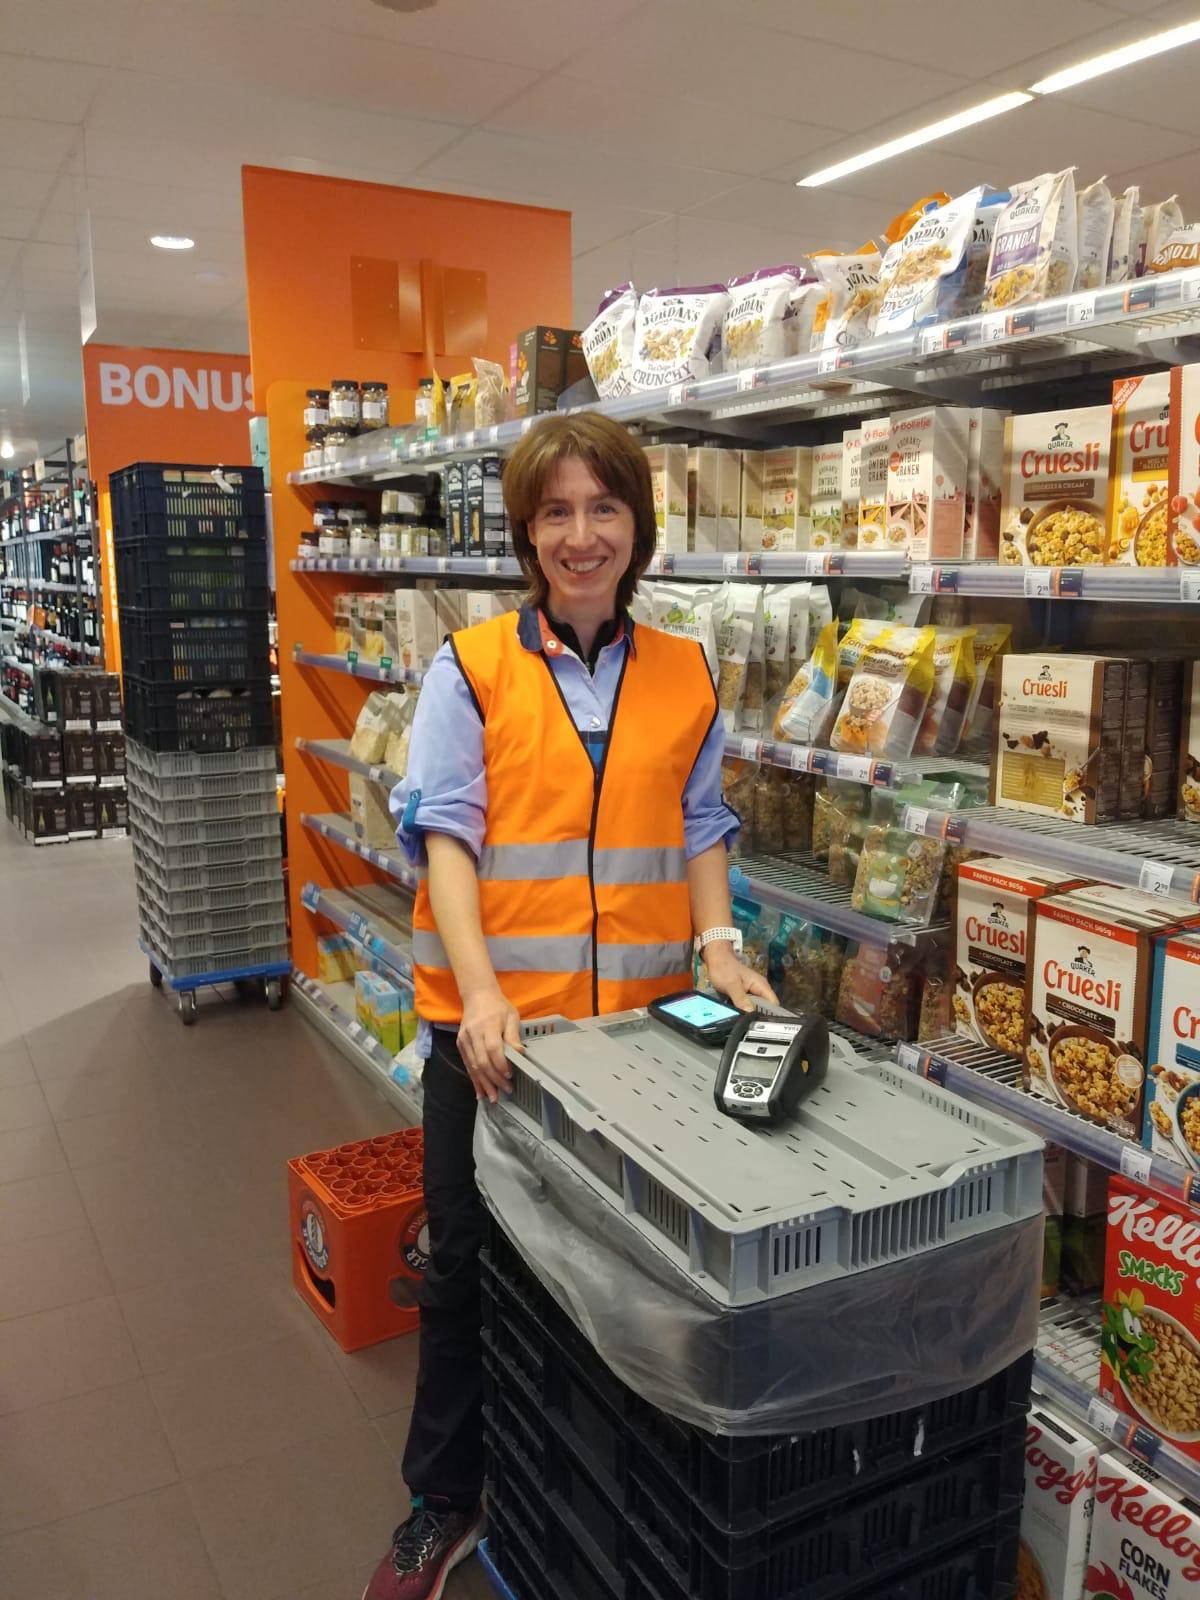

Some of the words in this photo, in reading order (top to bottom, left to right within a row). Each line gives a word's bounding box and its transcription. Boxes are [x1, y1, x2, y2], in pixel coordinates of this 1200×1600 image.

[1009, 204, 1041, 220] QUAKER
[996, 229, 1037, 254] GRANOLA
[632, 361, 693, 386] CRUNCHY
[898, 450, 921, 463] NTBIJT
[1047, 440, 1074, 451] QUAKER
[1020, 442, 1101, 479] Cruesli
[1022, 678, 1068, 698] Cruesli
[965, 916, 1025, 955] Cruesl
[1070, 961, 1096, 977] QUAKER
[1043, 959, 1121, 1012] Cruesli
[1061, 1001, 1099, 1021] CHOCOLATE
[1107, 1194, 1200, 1268] Kello
[1132, 1458, 1162, 1481] CORN
[1119, 1538, 1172, 1589] CORN
[1118, 1557, 1168, 1600] FLAKES
